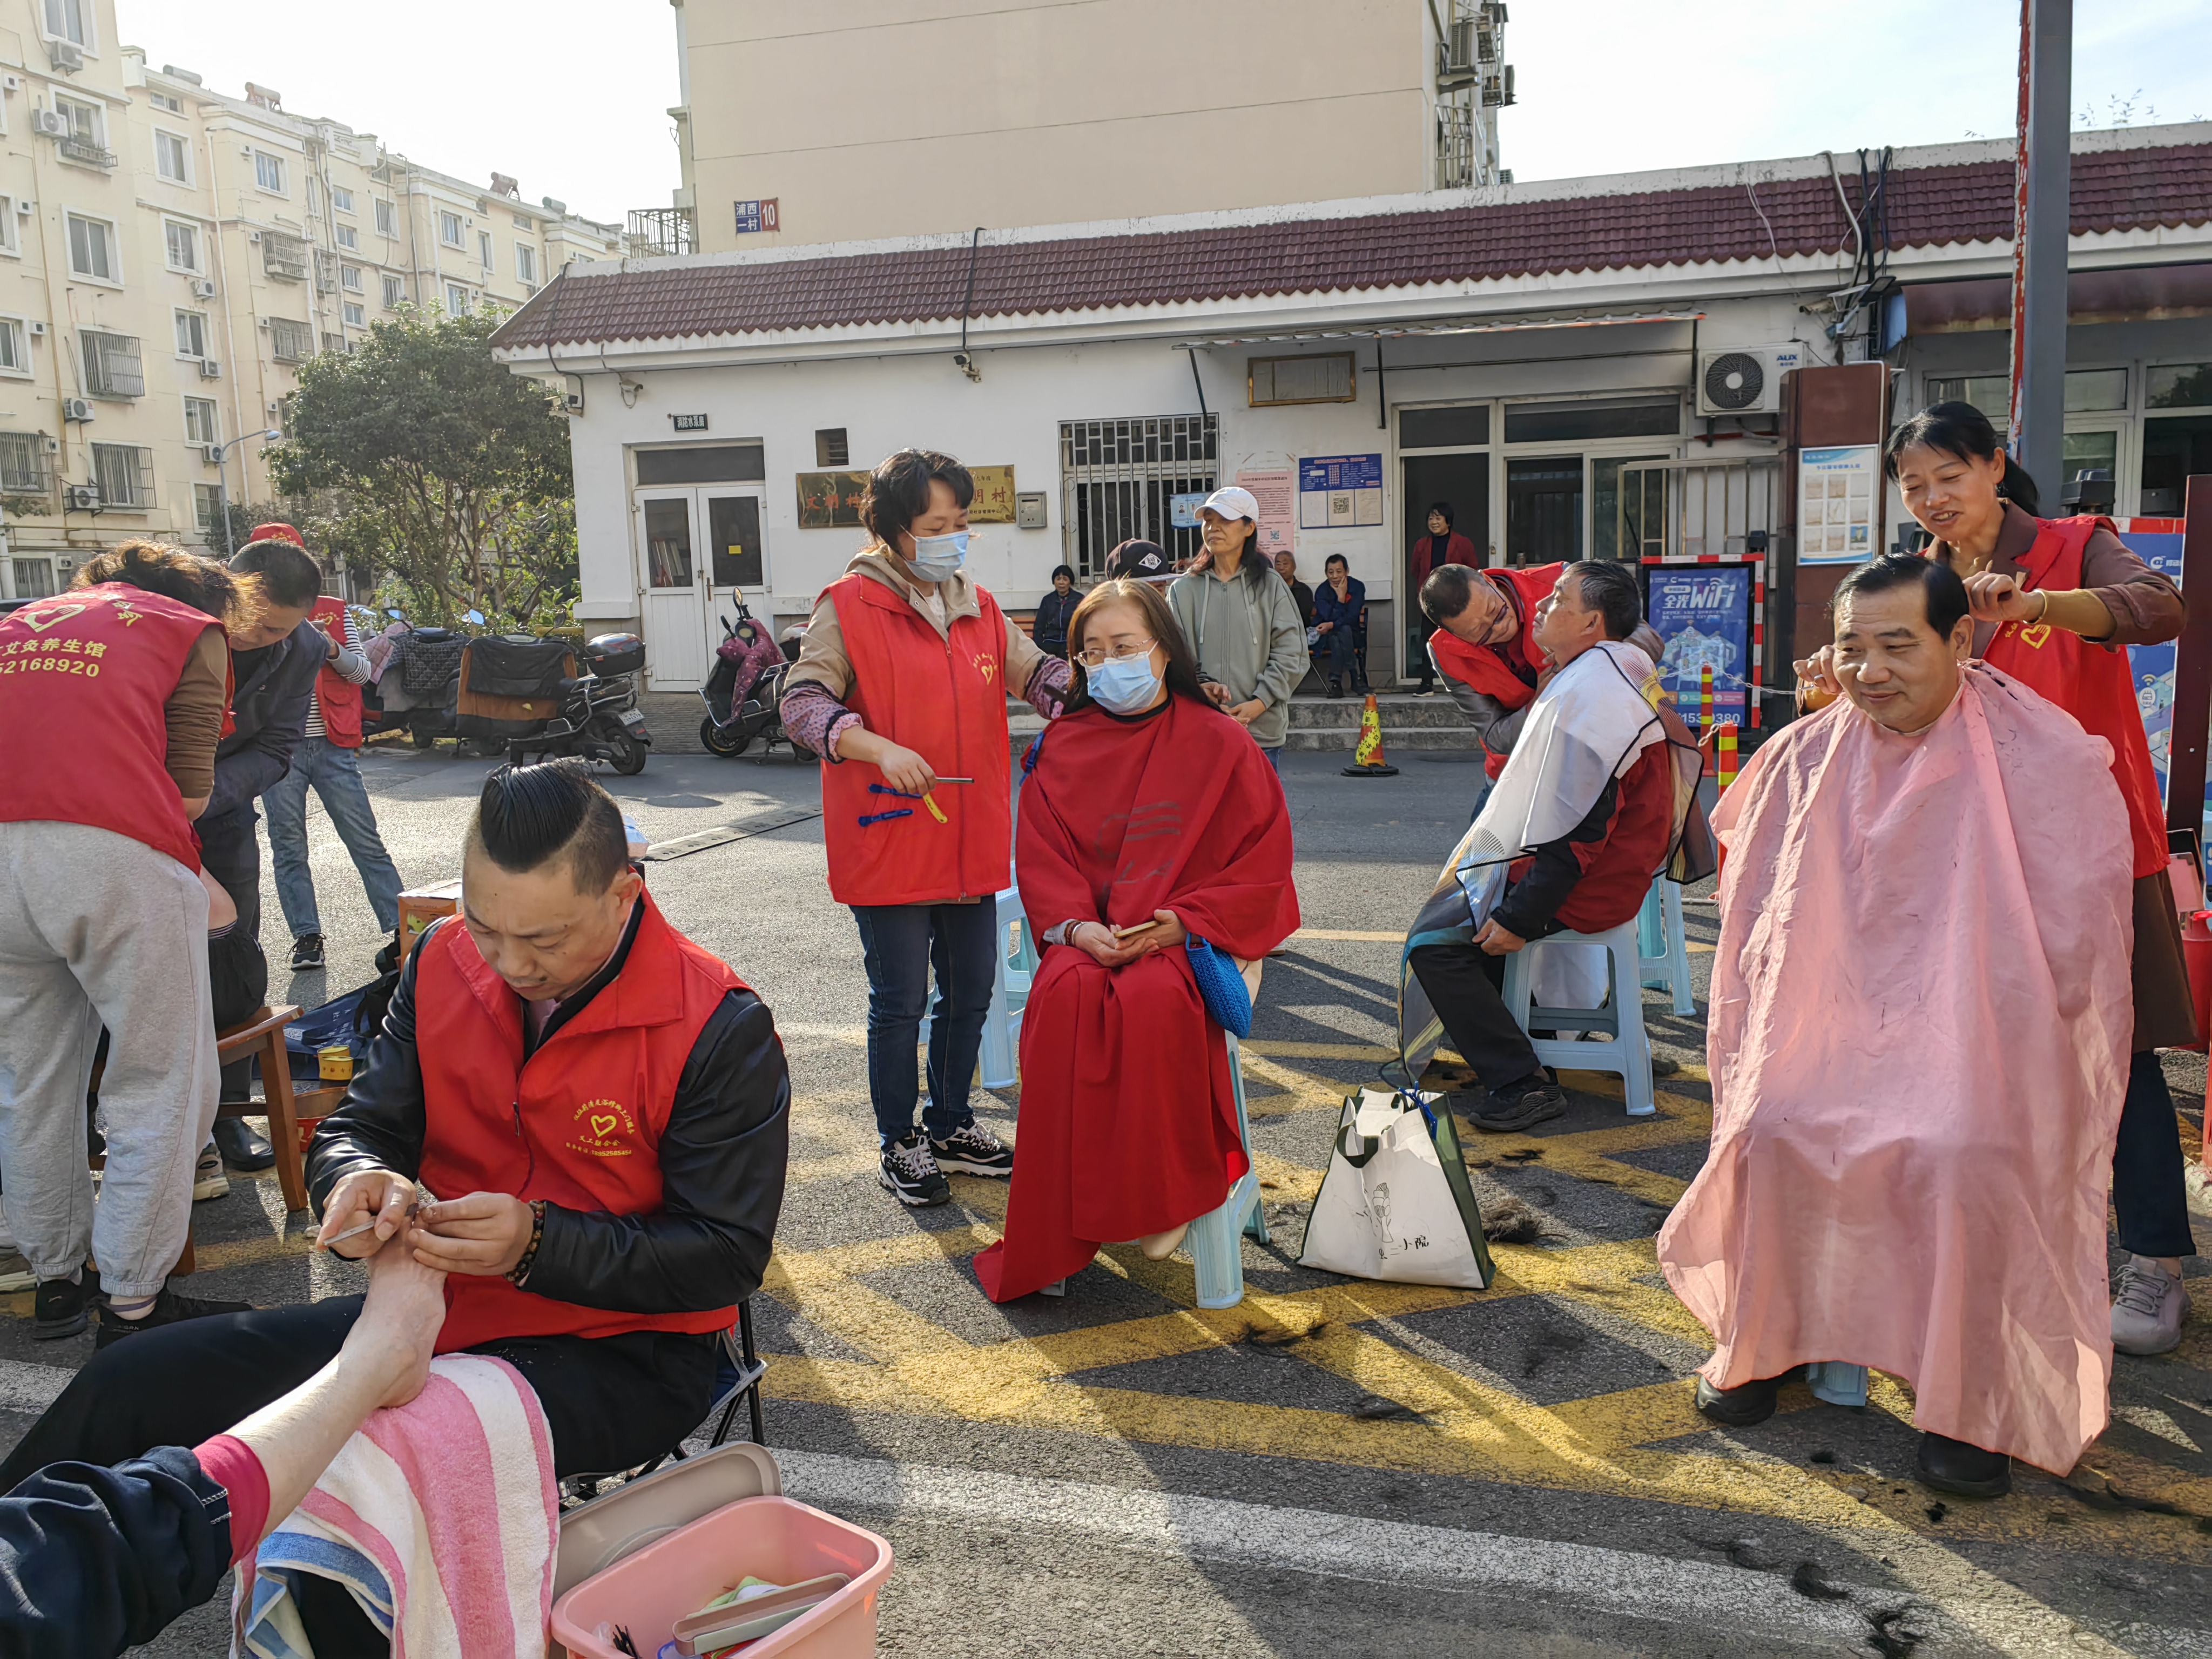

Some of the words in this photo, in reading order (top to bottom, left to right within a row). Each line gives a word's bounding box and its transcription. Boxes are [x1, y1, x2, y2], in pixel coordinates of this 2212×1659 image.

[736, 203, 757, 216] 浦西
[763, 204, 775, 226] 10
[737, 218, 758, 231] 一村
[677, 415, 704, 428] 消防水泵房
[805, 491, 860, 510] 文明村
[0, 638, 107, 658] 艾灸养生馆
